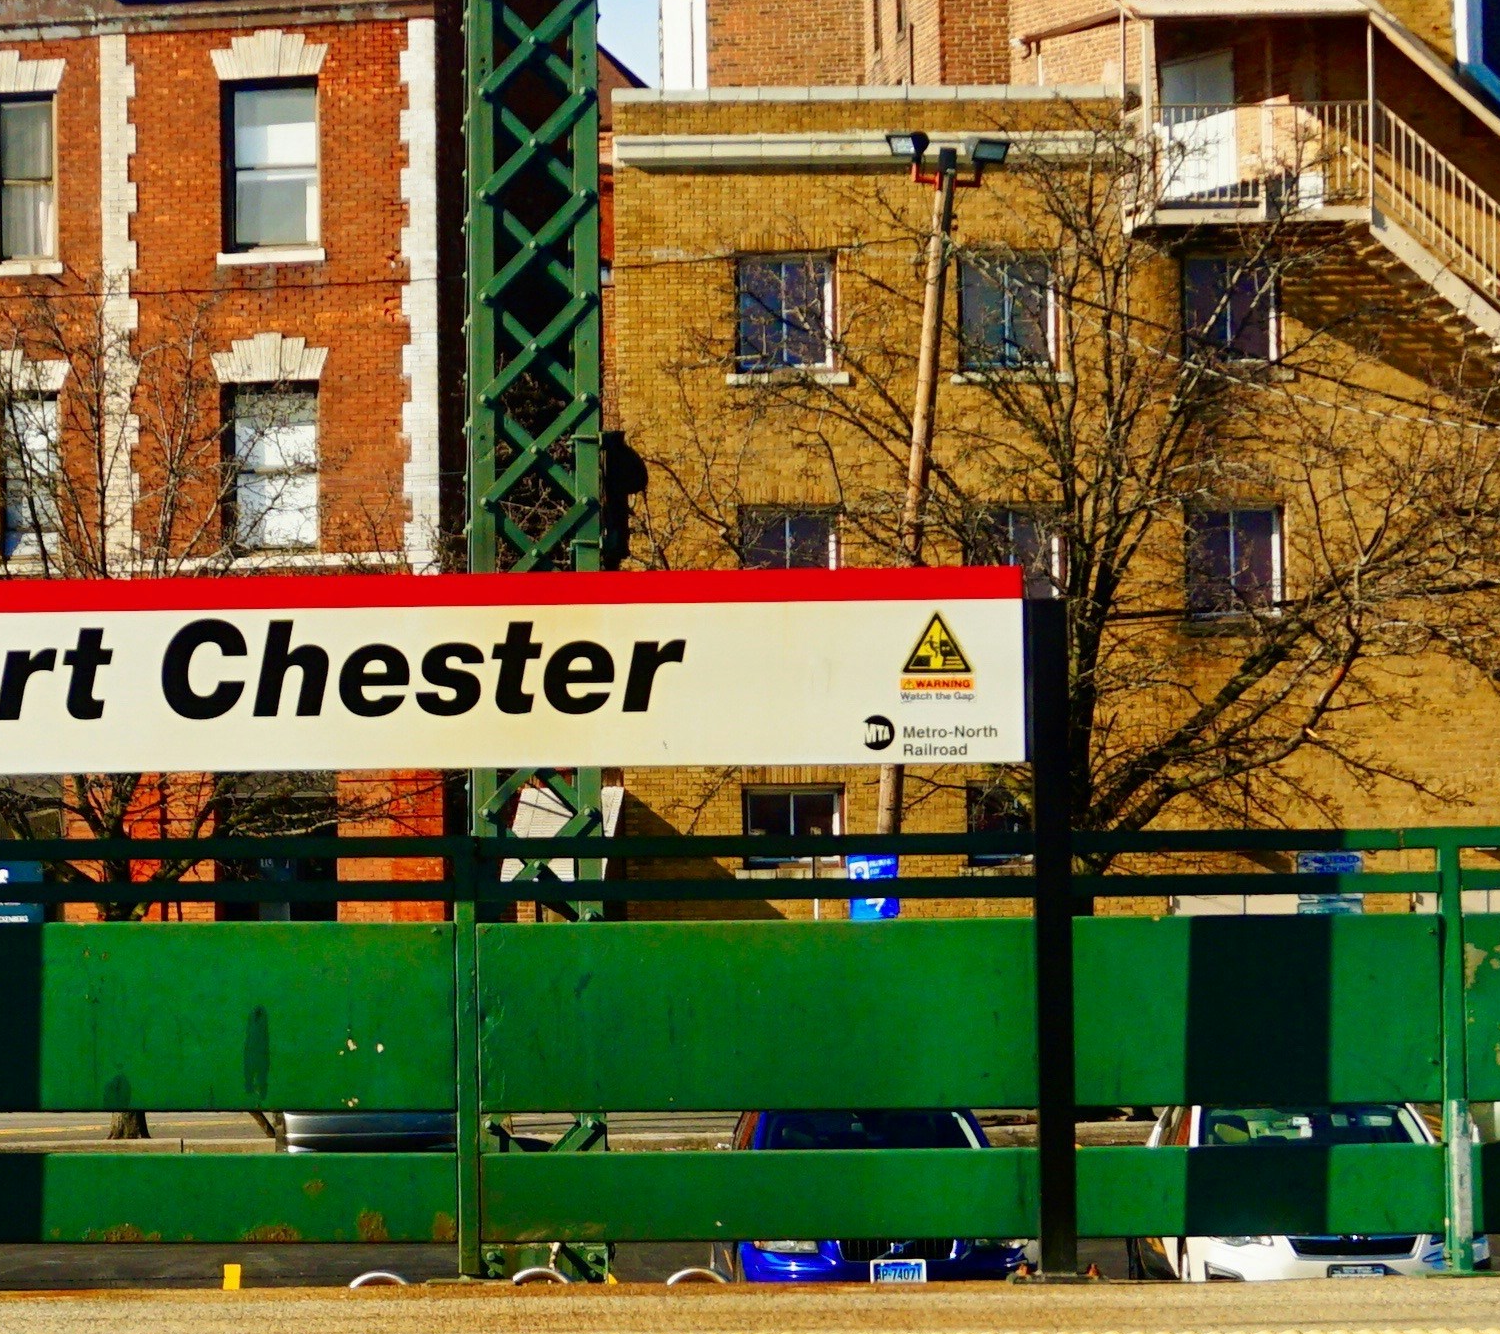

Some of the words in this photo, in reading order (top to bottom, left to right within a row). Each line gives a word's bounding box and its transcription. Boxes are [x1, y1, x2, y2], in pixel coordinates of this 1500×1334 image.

[160, 617, 688, 722] Chester
[915, 679, 971, 688] WARNING
[900, 691, 933, 700] Watch
[935, 691, 951, 700] the
[953, 691, 975, 702] Gap
[864, 723, 891, 745] MTA
[902, 725, 998, 739] Metro-North
[902, 743, 968, 757] Railroad
